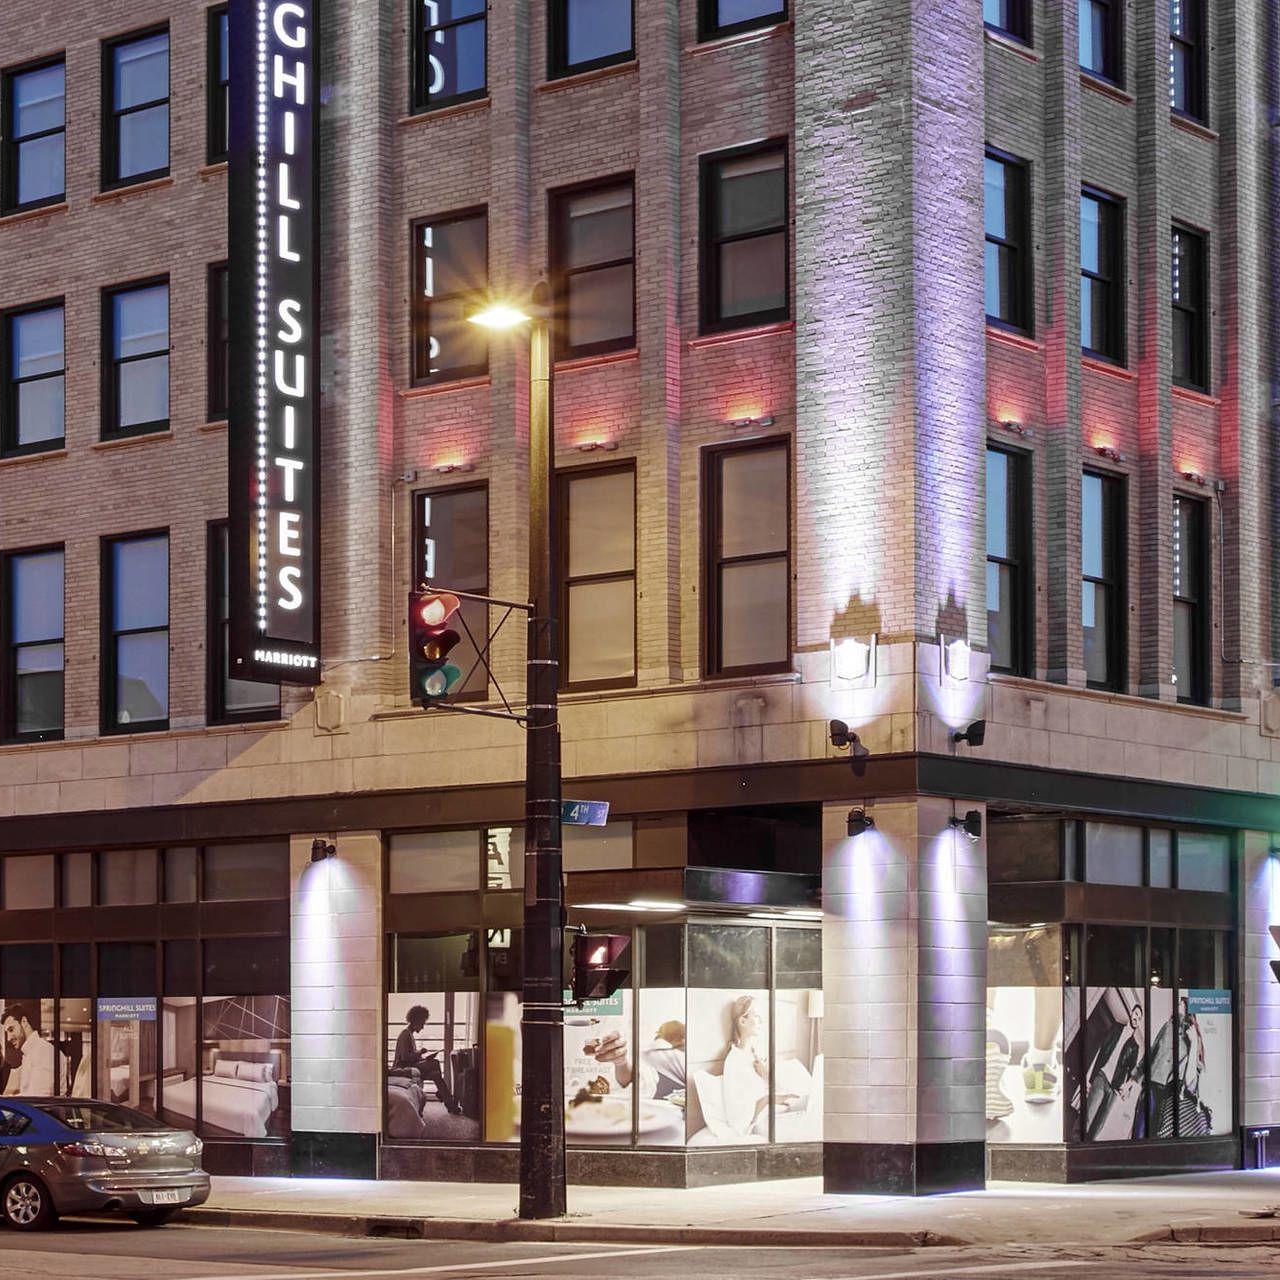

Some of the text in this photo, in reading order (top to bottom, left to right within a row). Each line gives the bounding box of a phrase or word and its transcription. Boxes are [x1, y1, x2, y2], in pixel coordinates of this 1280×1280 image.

[274, 298, 305, 611] SUITES
[254, 650, 318, 668] MARRIOTT
[570, 804, 589, 820] 4TH
[99, 1004, 156, 1012] SPRINGHILL SUITES
